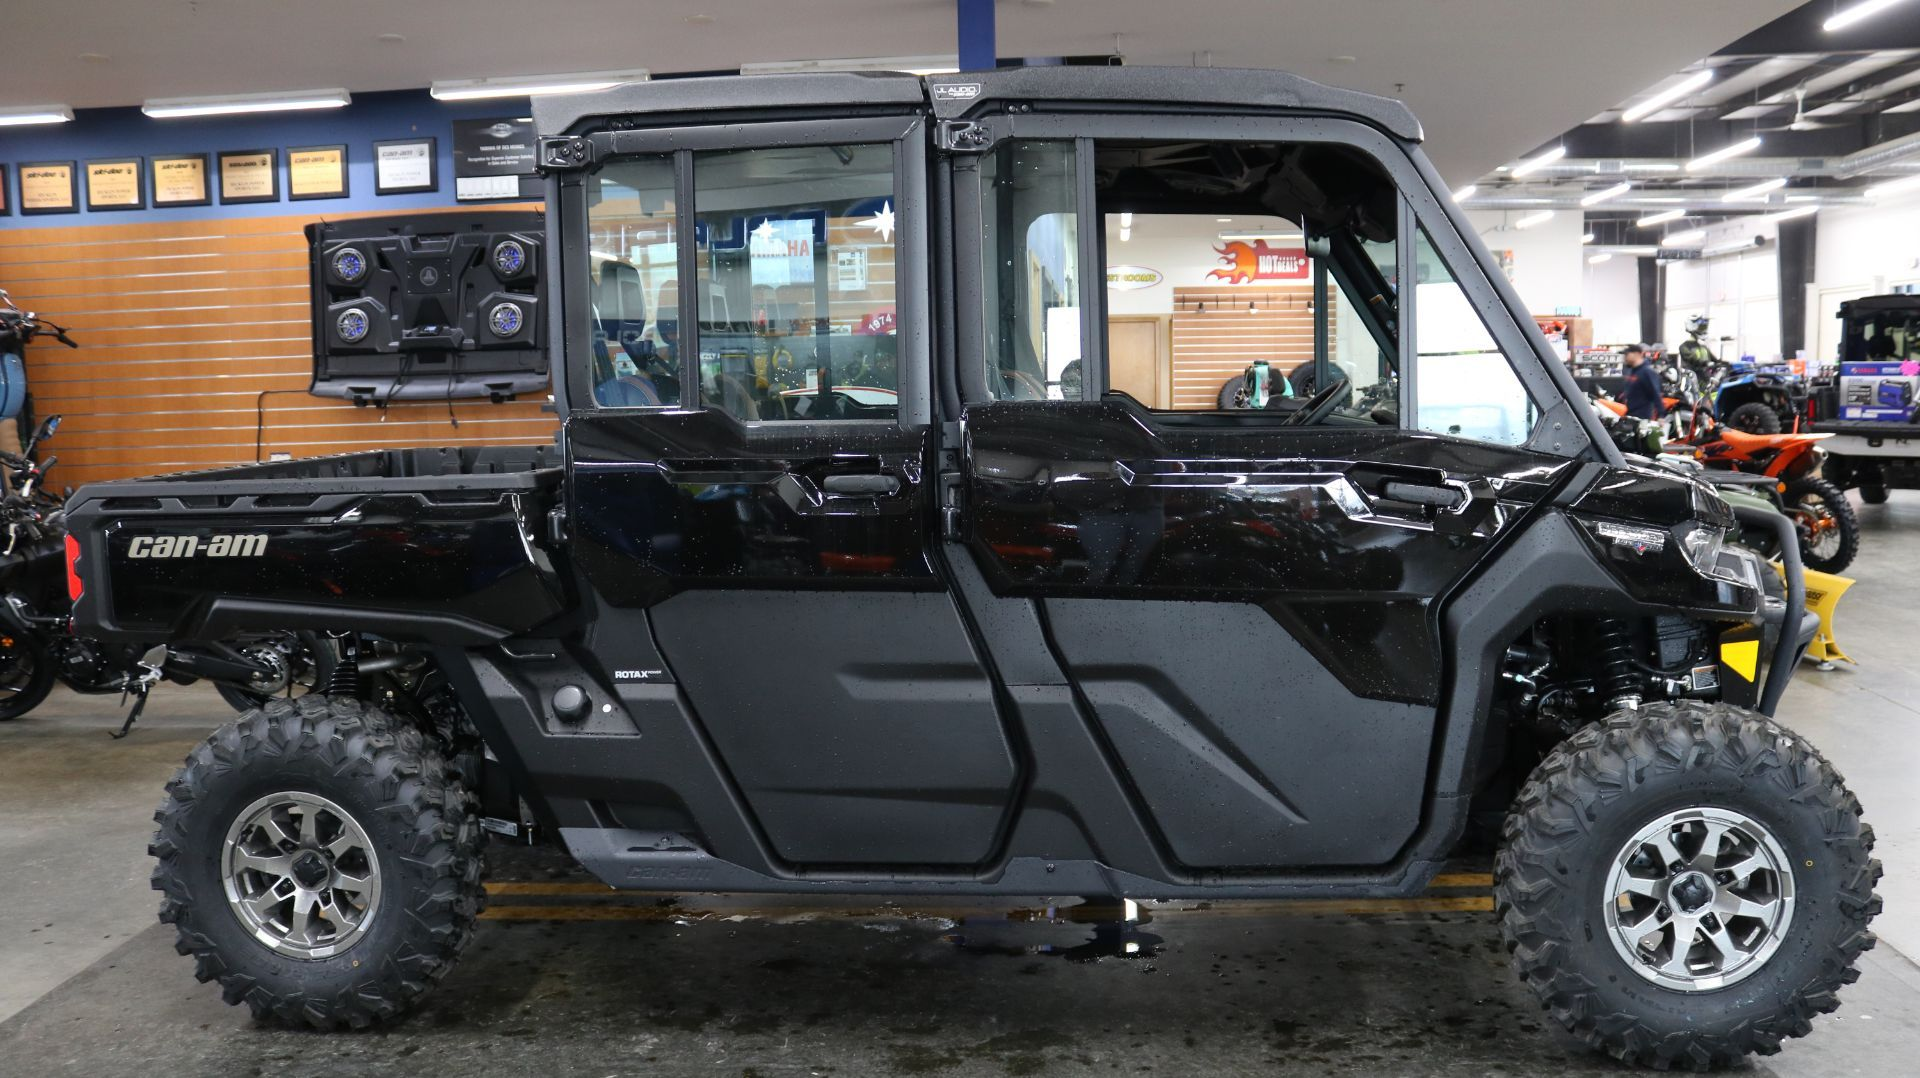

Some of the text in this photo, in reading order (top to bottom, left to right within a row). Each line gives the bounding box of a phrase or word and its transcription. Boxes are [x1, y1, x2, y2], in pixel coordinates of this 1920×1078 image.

[1258, 255, 1298, 274] HOT DEALS
[868, 313, 892, 332] 1974
[1582, 354, 1620, 363] SCOTT
[127, 533, 269, 559] can-am
[614, 670, 649, 679] ROTAX
